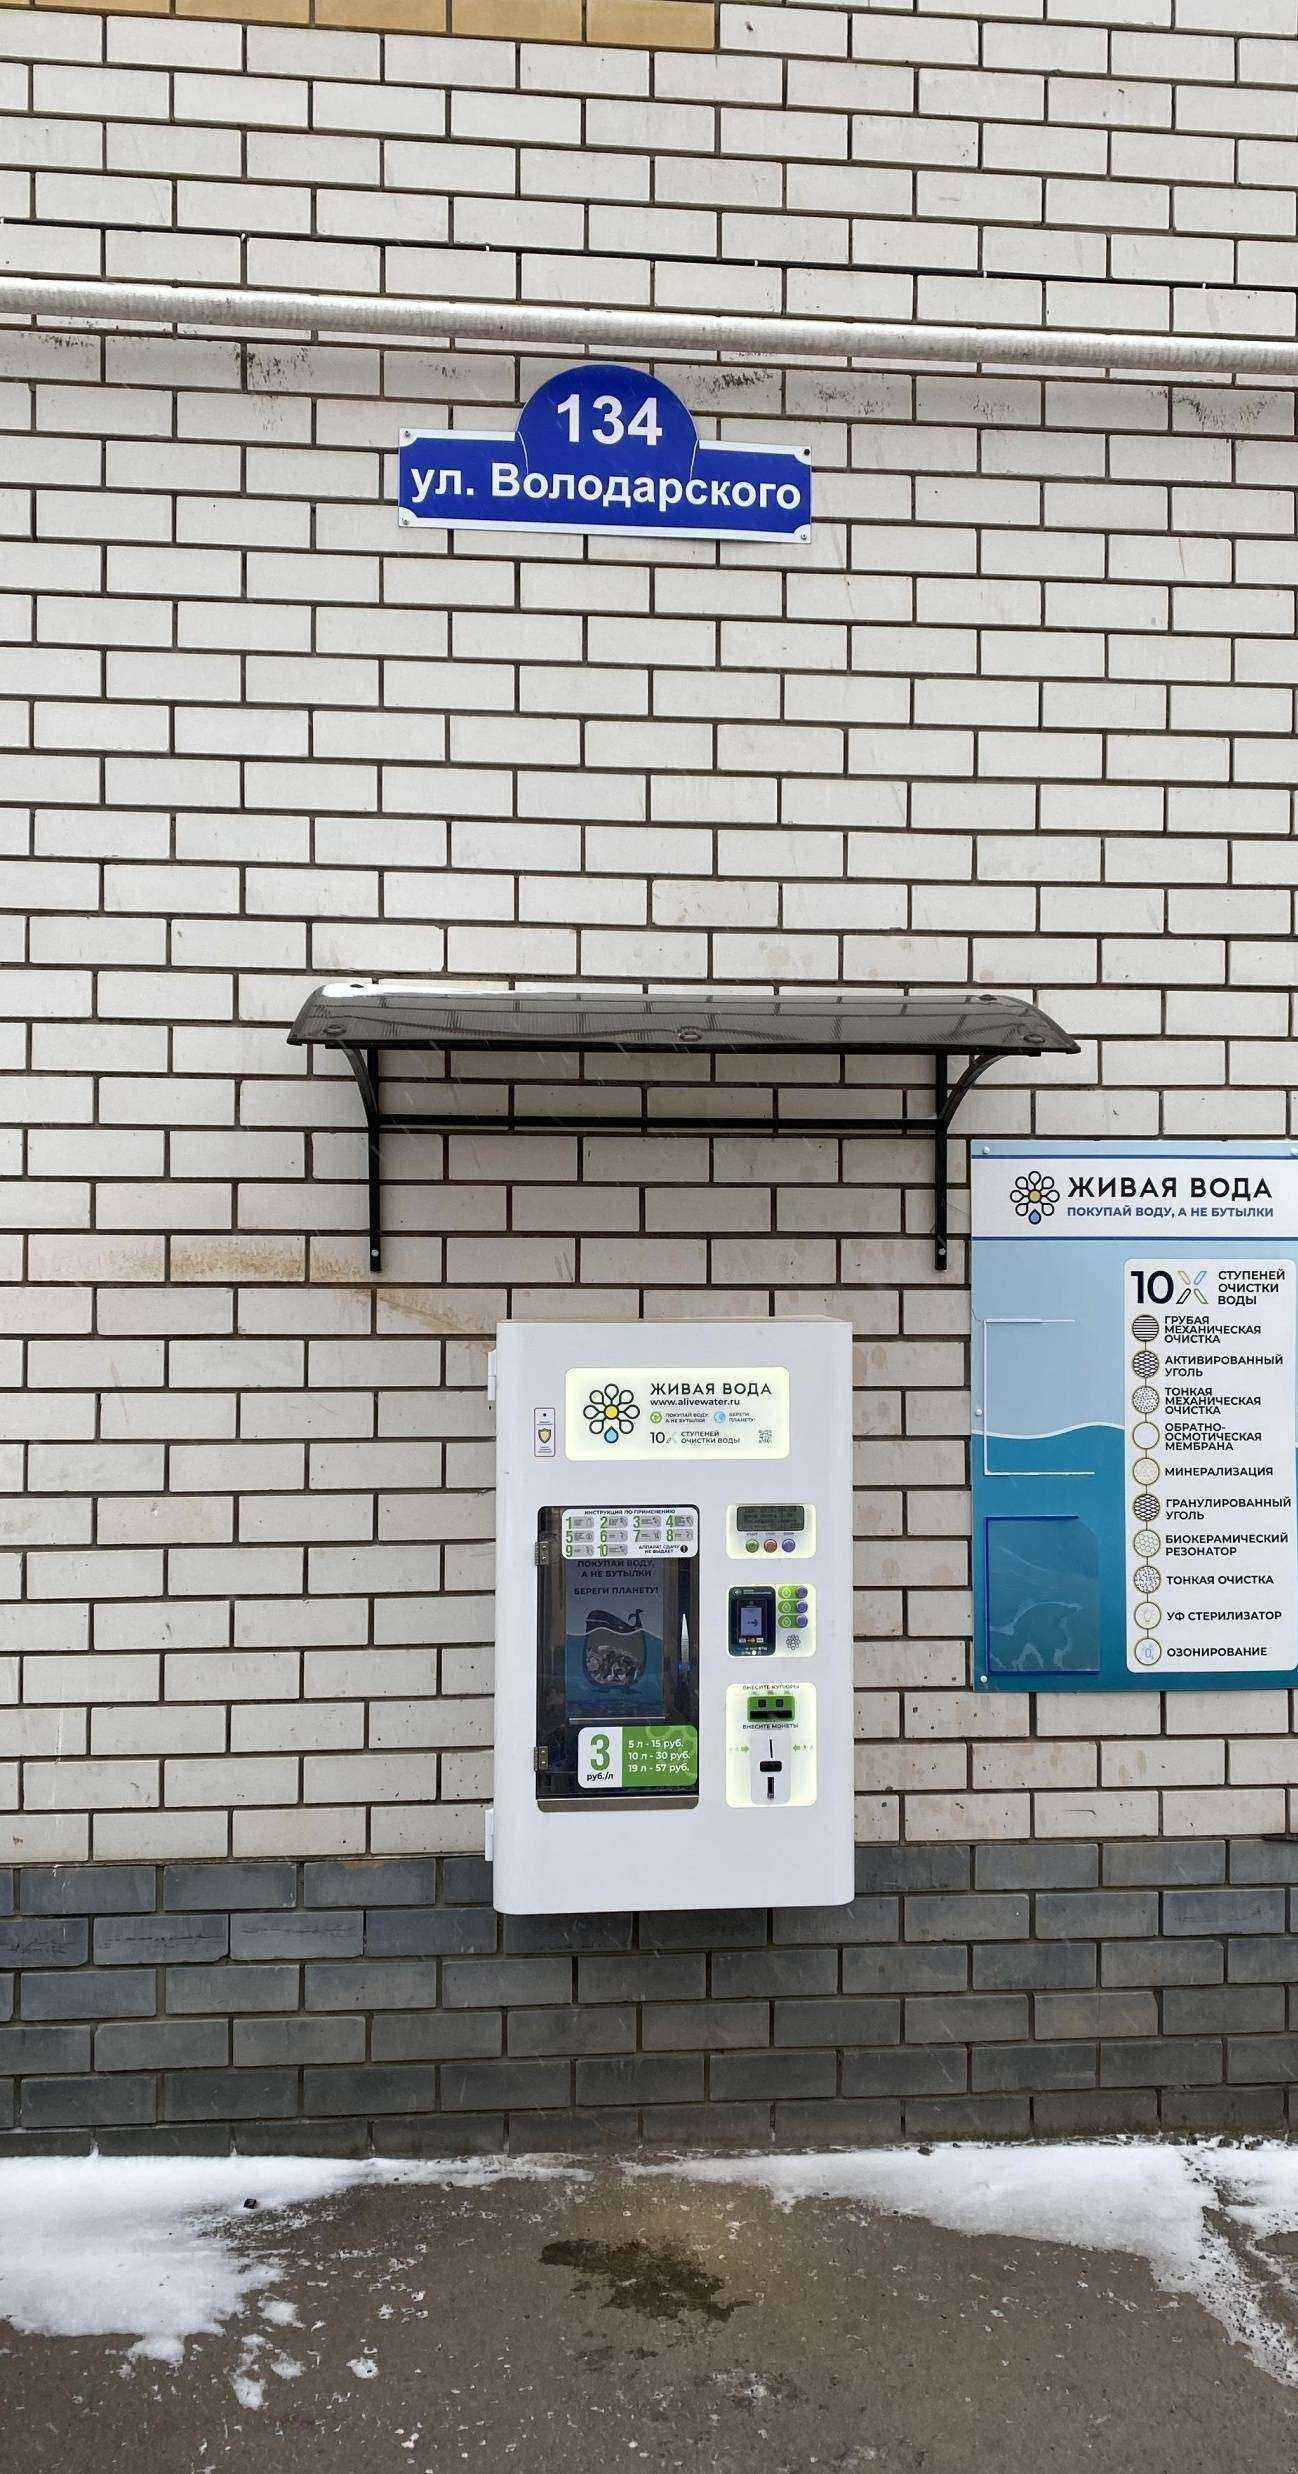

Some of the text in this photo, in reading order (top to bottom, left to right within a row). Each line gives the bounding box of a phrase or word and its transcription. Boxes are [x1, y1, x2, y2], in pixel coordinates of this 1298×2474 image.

[556, 393, 662, 446] 134
[410, 462, 800, 512] ул. Володарского
[1068, 1176, 1273, 1201] ЖИВАЯ ВОДА
[1067, 1205, 1274, 1219] ПОКУПАЙ ВОДУ, А НЕ БУТЫЛКИ
[1218, 1269, 1285, 1281] СТУПЕНЕЙ
[1218, 1283, 1279, 1293] ОЧИСТКИ
[1218, 1296, 1257, 1306] ВОДЫ
[1165, 1316, 1209, 1325] ГРУБАЯ
[1165, 1325, 1261, 1334] МЕХАНИЧЕСКАЯ
[1165, 1335, 1220, 1343] ОЧИСТКА
[1165, 1354, 1283, 1364] АКТИВИРОВАННЫЙ
[1165, 1368, 1203, 1378] УГОЛЬ
[650, 1383, 771, 1396] ЖИВАЯ ВОДА
[1165, 1387, 1212, 1396] ТОНКАЯ
[1165, 1397, 1261, 1406] МЕХАНИЧЕСКАЯ
[1165, 1406, 1221, 1415] ОЧИСТКА
[1165, 1423, 1226, 1432] ОБРАТНО-
[1165, 1432, 1262, 1441] ОСМОТИЧЕСКАЯ
[1165, 1442, 1233, 1451] МЕМБРАНА
[1165, 1467, 1273, 1478] МИНЕРАЛИЗАЦИЯ
[1166, 1497, 1291, 1508] ГРАНУЛИРОВАННЫЙ
[1166, 1511, 1204, 1520] УГОЛЬ
[566, 1517, 572, 1529] 1
[600, 1516, 607, 1528] 2
[633, 1516, 640, 1528] 3
[666, 1515, 673, 1527] 4
[566, 1530, 573, 1543] 5
[601, 1530, 607, 1542] 6
[633, 1530, 640, 1542] 7
[667, 1529, 673, 1541] 8
[1165, 1532, 1288, 1544] БИОКЕРАМИЧЕСКИЙ
[566, 1545, 572, 1557] 9
[1165, 1547, 1237, 1556] РЕЗОНАТОР
[1166, 1575, 1274, 1585] ТОНКАЯ ОЧИСТКА
[574, 1587, 608, 1595] БЕРЕГИ
[1166, 1611, 1282, 1621] УФ СТЕРИЛИЗАТОР
[1167, 1648, 1267, 1657] ОЗОНИРОВАНИЕ
[663, 1739, 683, 1749] руб.
[591, 1734, 610, 1771] 3
[628, 1752, 638, 1760] 10
[670, 1751, 690, 1761] руб.
[655, 1764, 667, 1772] 57
[670, 1763, 690, 1773] руб.
[587, 1771, 613, 1781] руб./л
